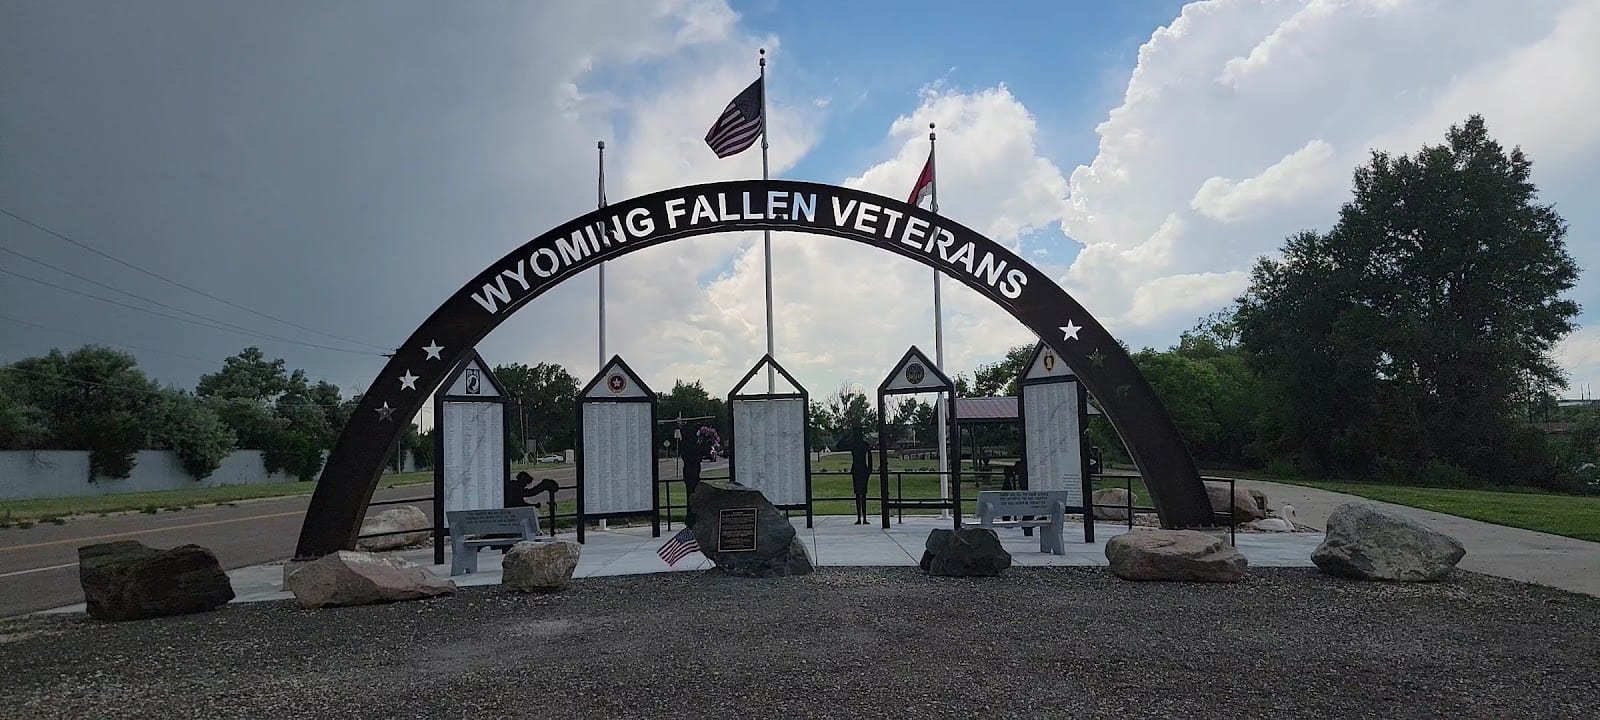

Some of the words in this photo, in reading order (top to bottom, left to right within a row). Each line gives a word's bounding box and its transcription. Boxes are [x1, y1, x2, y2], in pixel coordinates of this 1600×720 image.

[471, 207, 655, 314] WYOMING
[665, 191, 817, 229] FALLEN
[832, 196, 1028, 299] VETERANS
